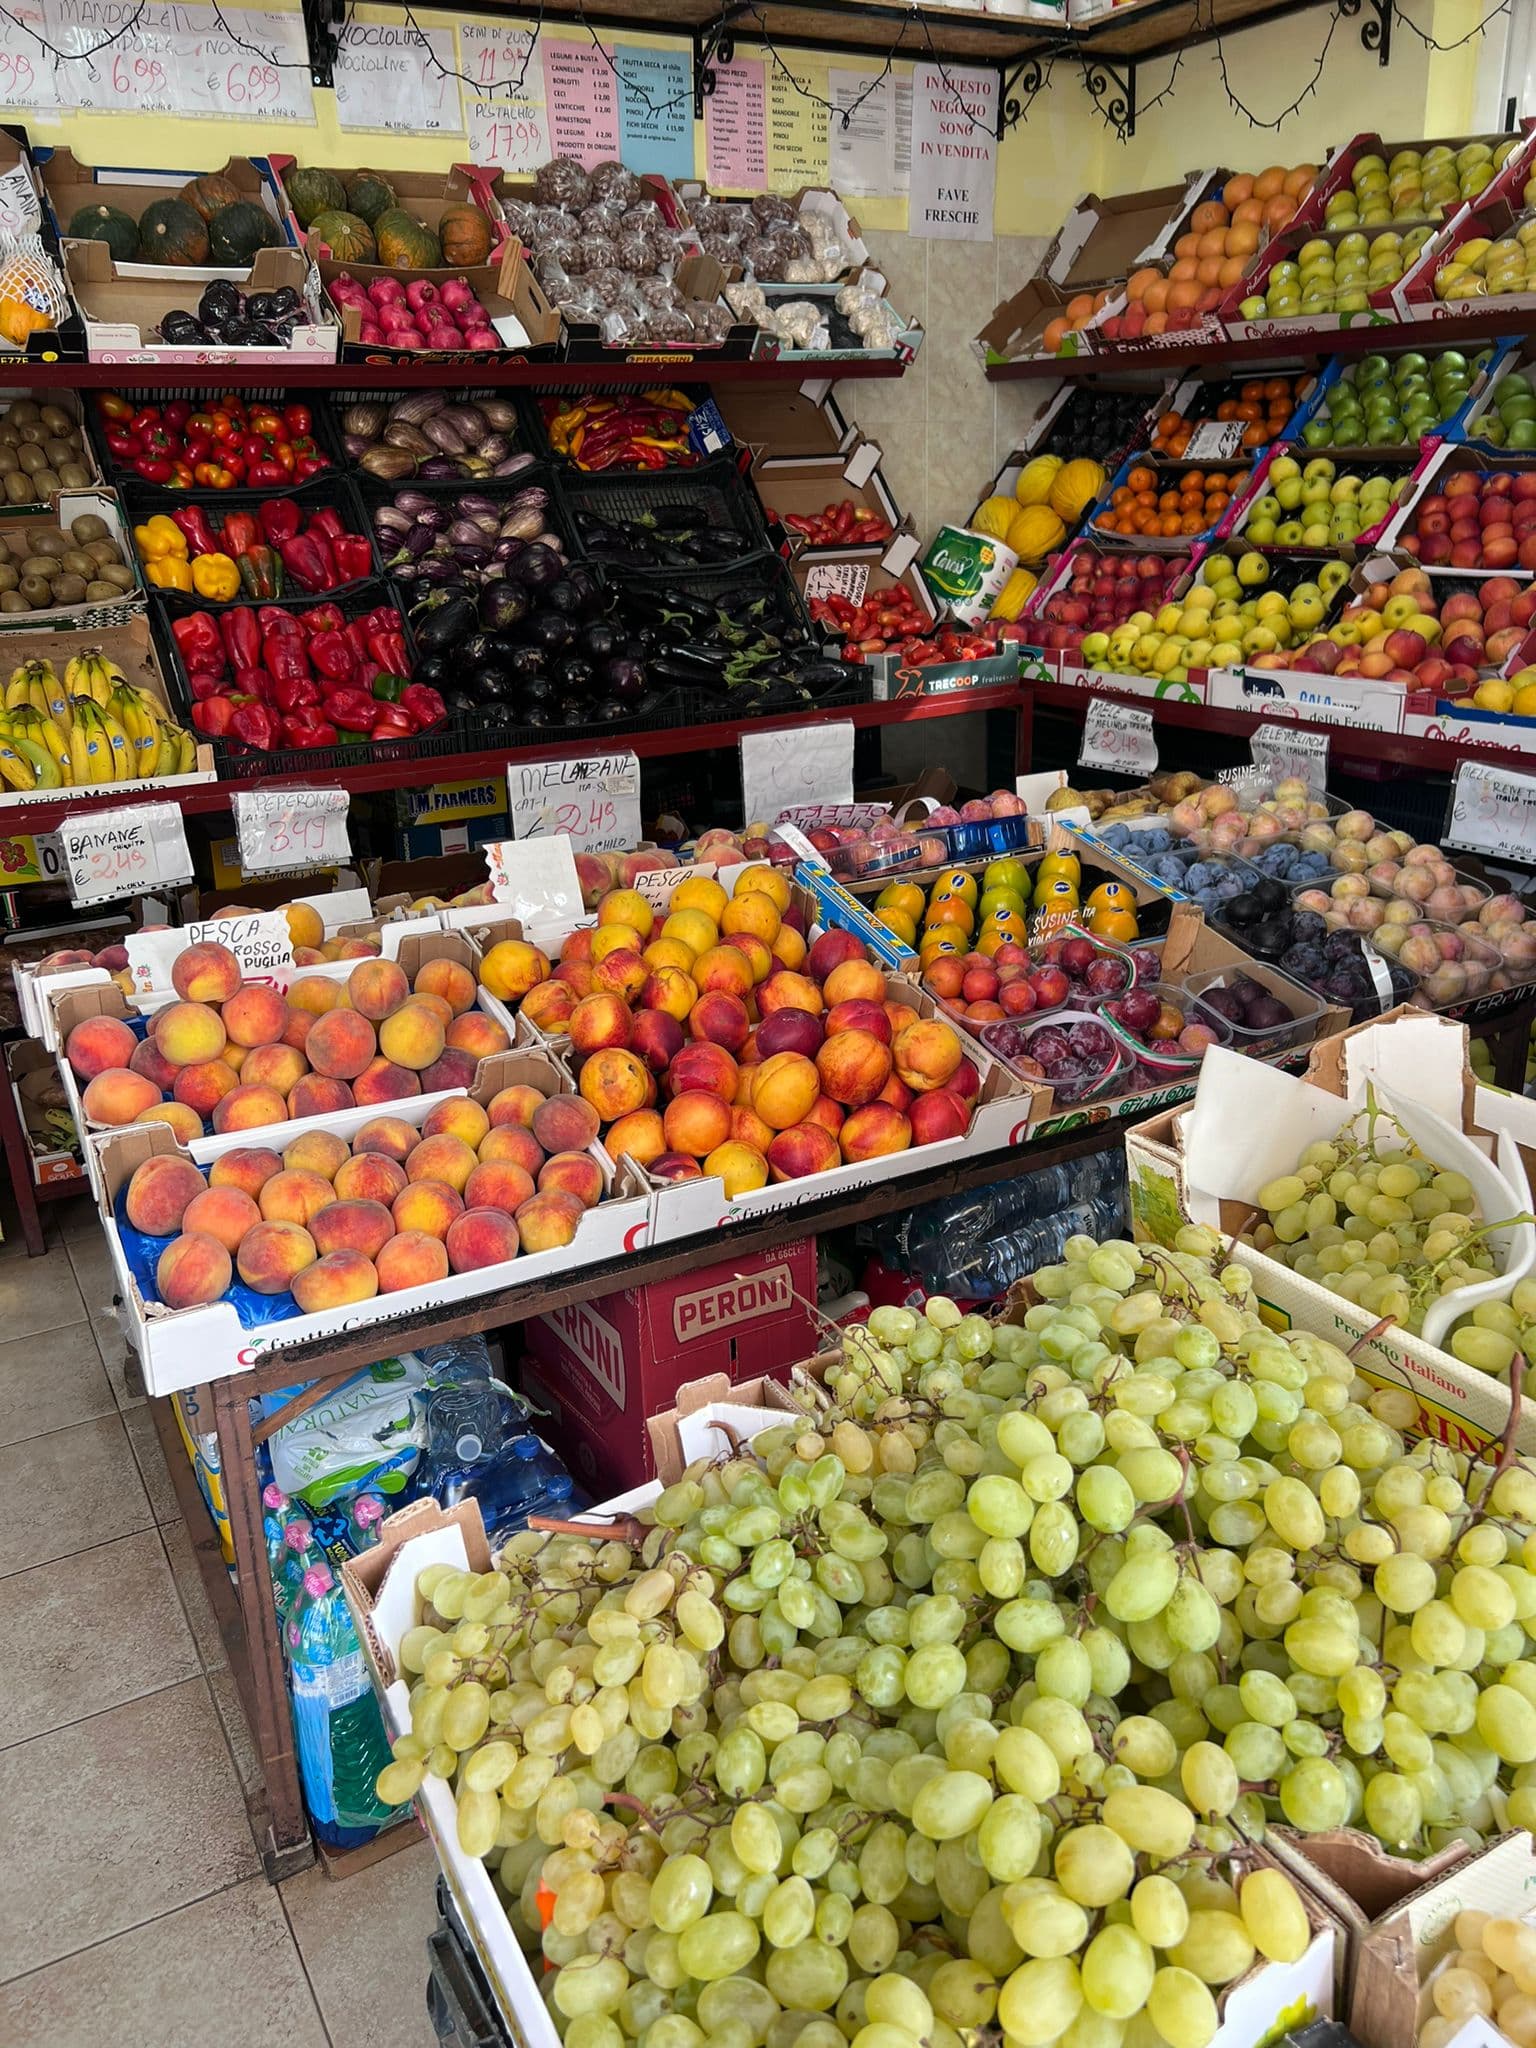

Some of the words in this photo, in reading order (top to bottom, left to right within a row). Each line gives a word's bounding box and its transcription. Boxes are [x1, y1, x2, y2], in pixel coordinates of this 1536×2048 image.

[462, 26, 487, 38] SEMI
[550, 52, 573, 60] LEGUMI
[623, 59, 643, 67] FRUTTA
[644, 61, 660, 69] SECCA
[551, 64, 584, 73] CANNELLINI
[553, 78, 580, 86] BORLOTTI
[926, 76, 940, 89] IN
[942, 78, 991, 96] QUESTO
[475, 103, 536, 120] PISTACHIO
[930, 99, 986, 117] NEGOZIO
[555, 116, 591, 125] MINESTRONE
[939, 122, 974, 136] SONO
[557, 141, 585, 149] PRODOTTI
[921, 142, 933, 155] IN
[935, 143, 990, 160] VENDITA
[557, 152, 583, 160] ITALIANA
[937, 188, 969, 202] FAVE
[925, 208, 979, 224] FRESCHE
[929, 675, 979, 691] TRECOOP
[1310, 712, 1340, 726] della
[1345, 716, 1383, 733] Frutta
[1088, 731, 1100, 750] €
[1218, 764, 1257, 784] SUSINE
[1461, 767, 1494, 780] MELE
[434, 785, 496, 811] FARMERS
[1496, 794, 1519, 803] ITALIA
[1454, 801, 1466, 821] €
[70, 826, 142, 853] BANANE
[74, 869, 90, 885] €
[635, 870, 693, 890] PESCA
[1033, 909, 1079, 934] SUSINE
[1082, 906, 1096, 918] ITA
[190, 919, 260, 946] PESCA
[234, 941, 281, 956] ROSSO
[244, 952, 290, 968] PUGLIA
[1119, 1090, 1166, 1116] Fichi
[765, 1253, 777, 1264] DA
[679, 1274, 790, 1333] PERONI
[1403, 1354, 1468, 1401] Italiano
